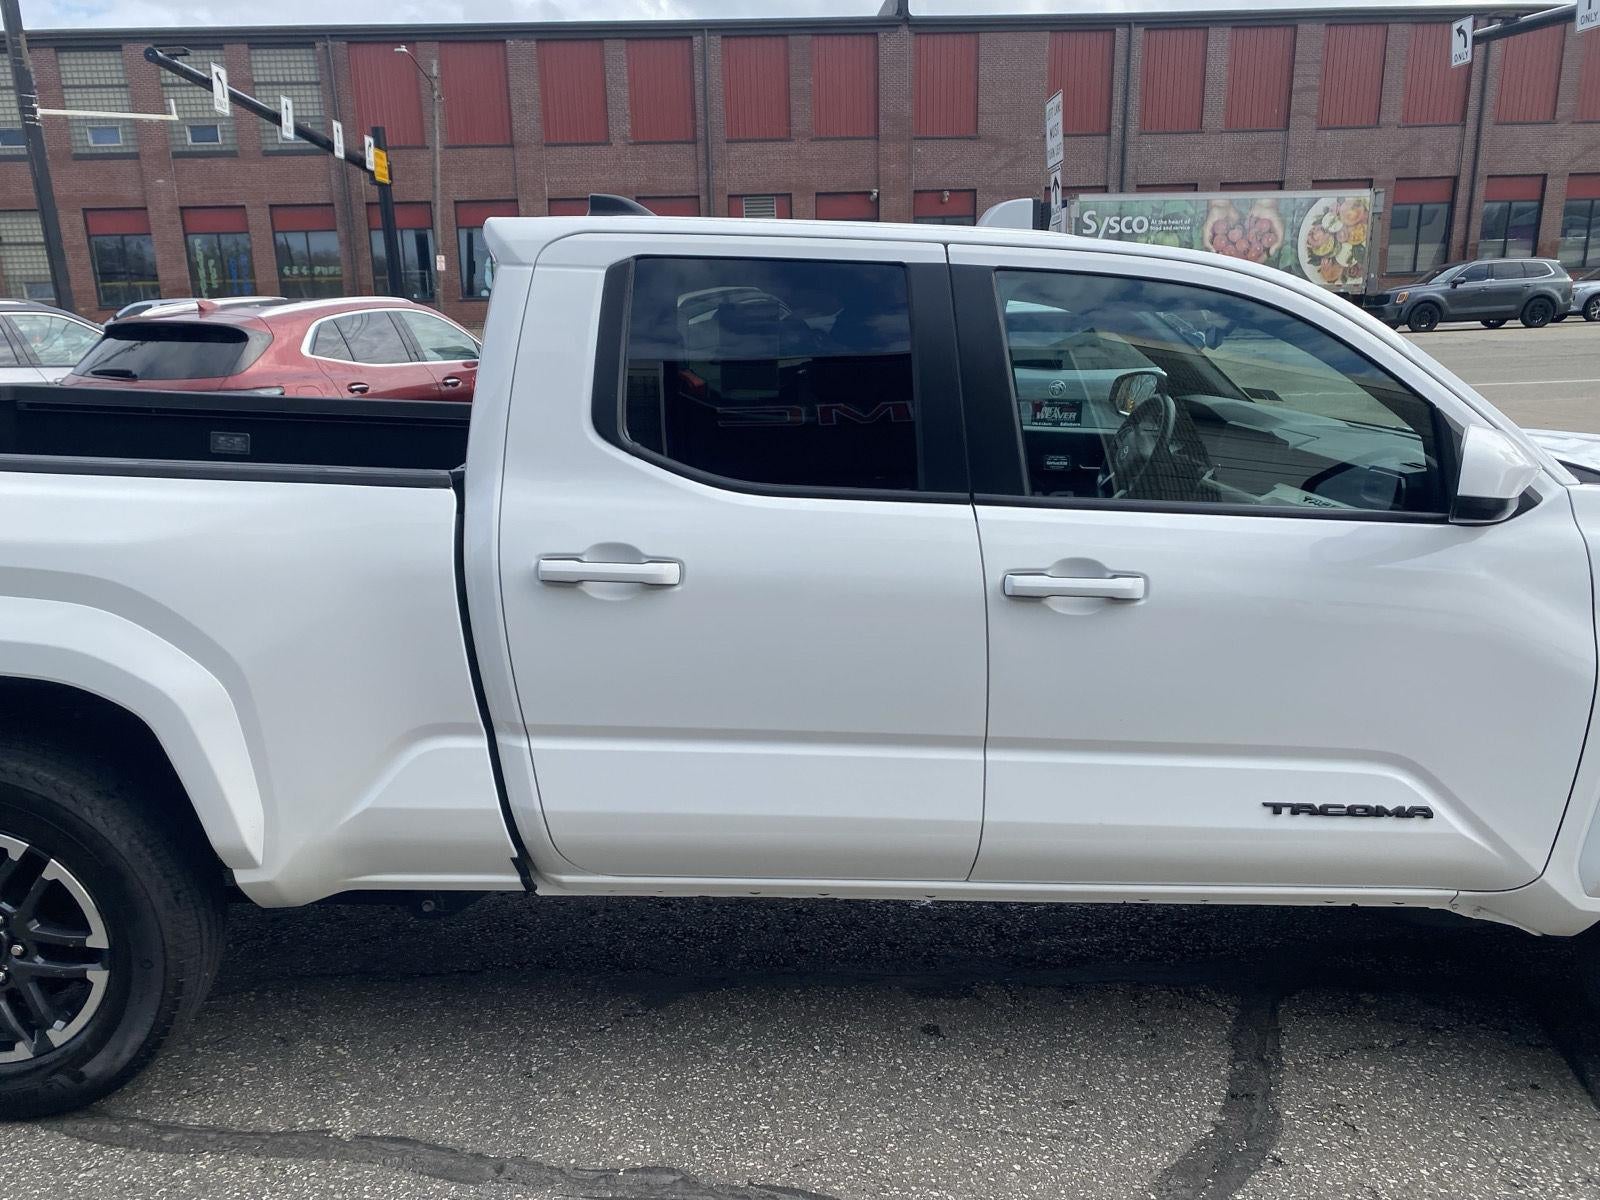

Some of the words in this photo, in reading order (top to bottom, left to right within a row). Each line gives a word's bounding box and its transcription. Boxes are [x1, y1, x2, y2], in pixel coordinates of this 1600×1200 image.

[1580, 12, 1598, 25] ONLY
[1454, 51, 1468, 62] ONLY
[1082, 210, 1149, 240] Sysco
[1036, 411, 1077, 421] WEAVER
[1262, 801, 1434, 819] TACOMA
